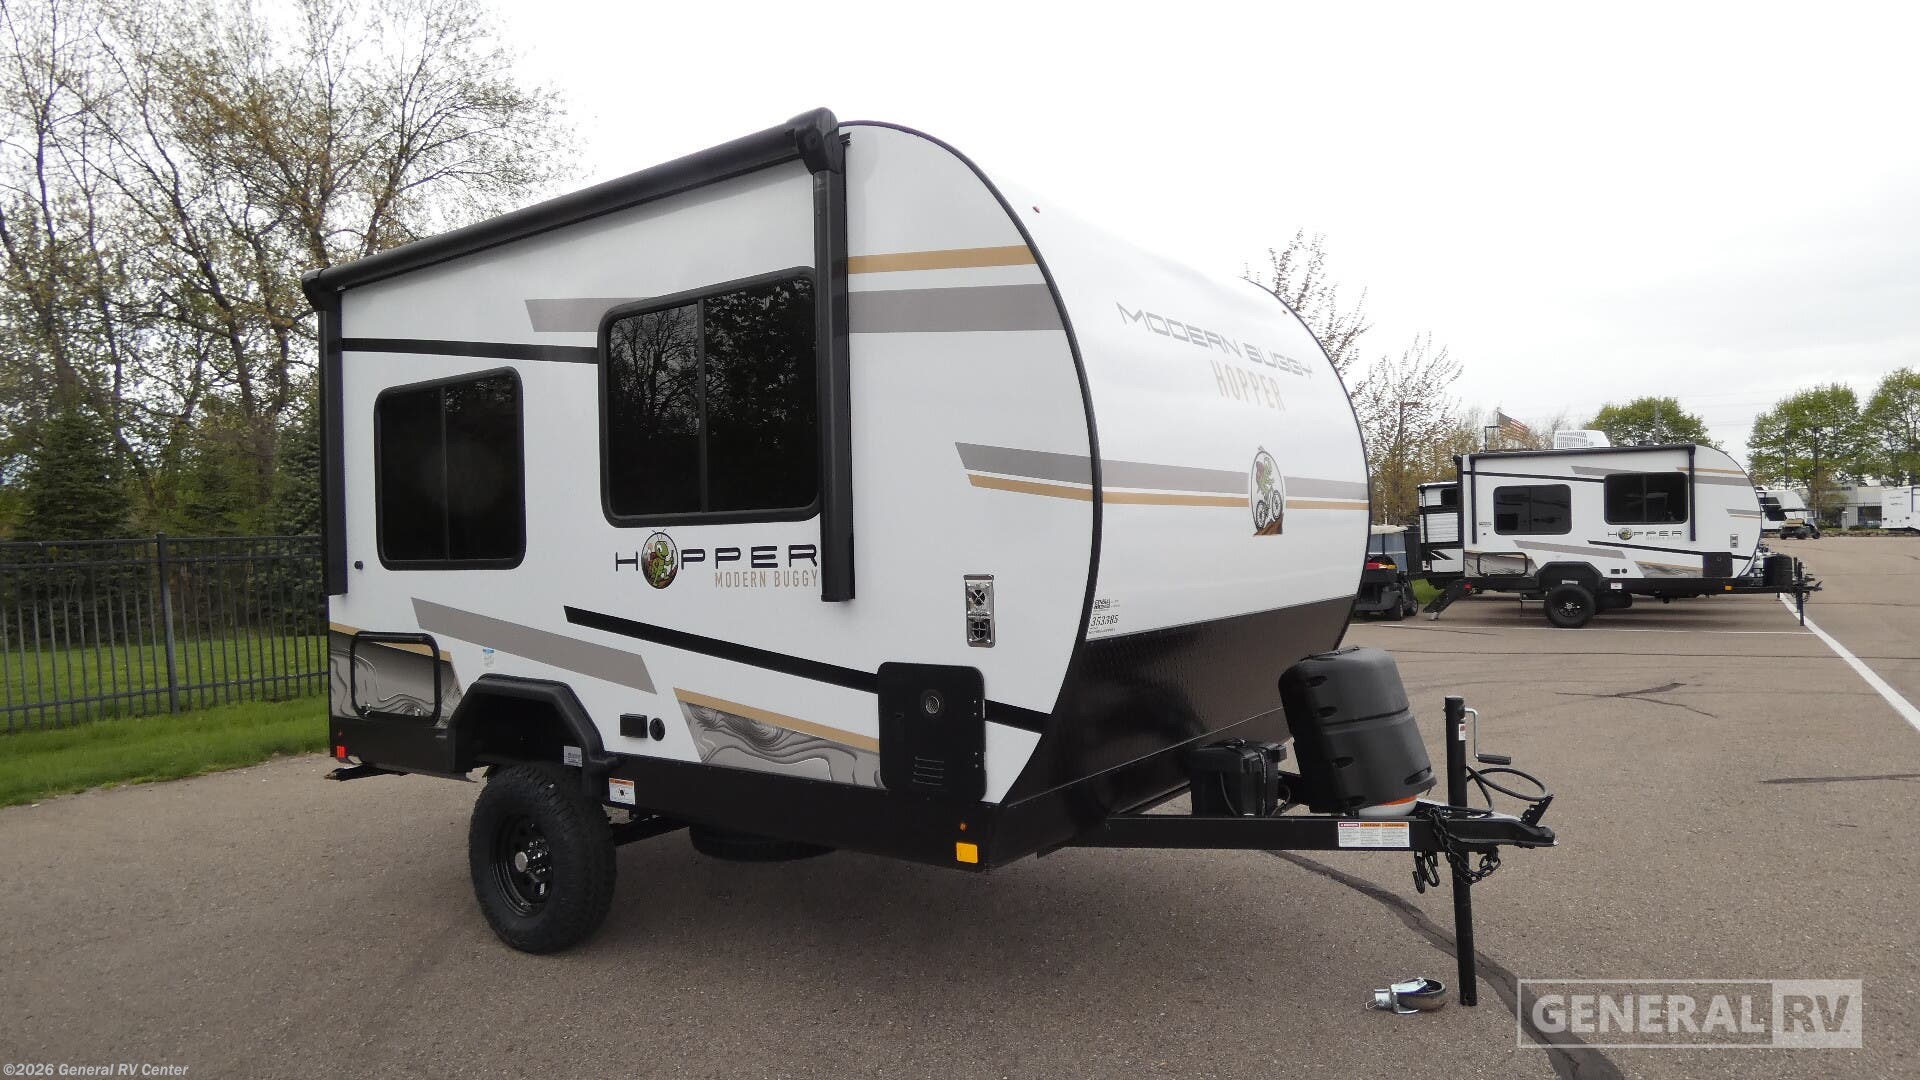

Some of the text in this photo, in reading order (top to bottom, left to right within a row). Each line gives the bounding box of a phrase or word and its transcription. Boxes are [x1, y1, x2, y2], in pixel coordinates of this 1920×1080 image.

[1116, 301, 1313, 379] MODERN BUGGY
[1210, 359, 1286, 411] HOPPER
[714, 569, 818, 589] MODERN BUGGY
